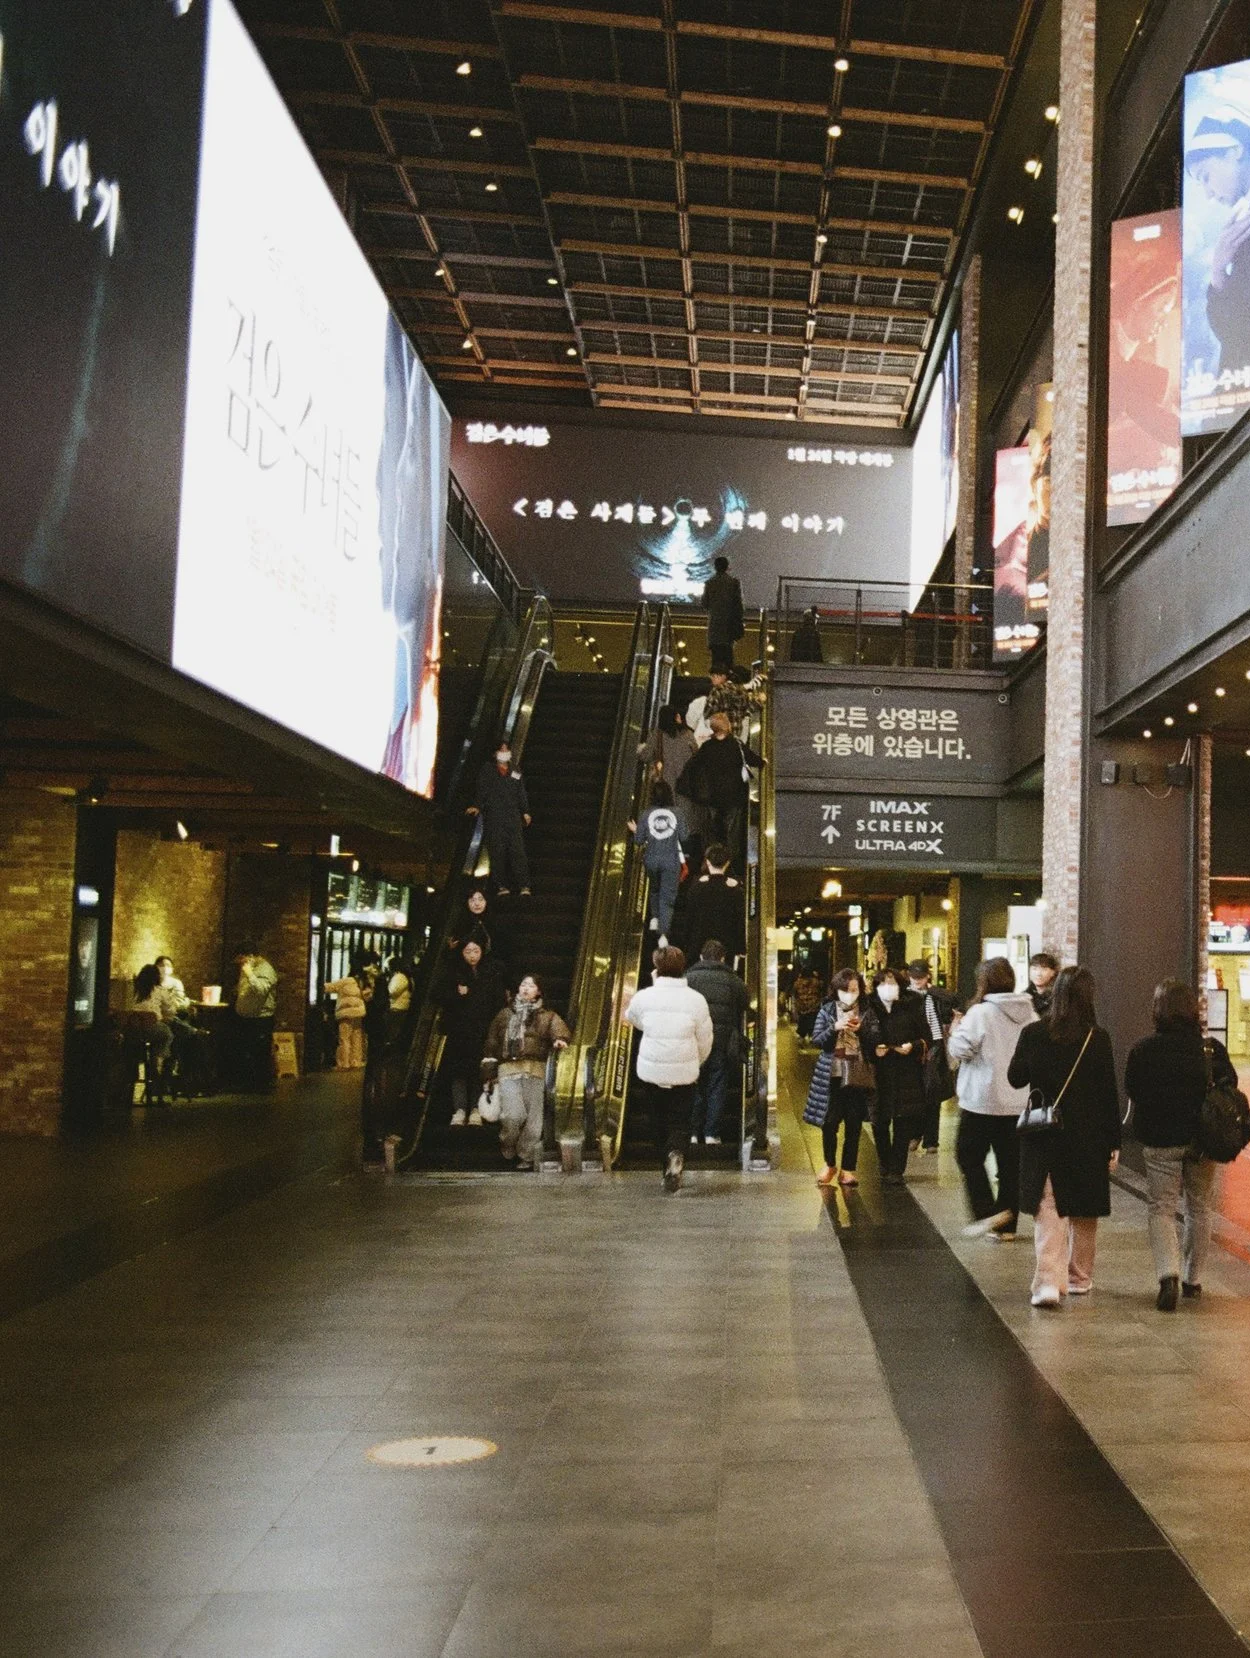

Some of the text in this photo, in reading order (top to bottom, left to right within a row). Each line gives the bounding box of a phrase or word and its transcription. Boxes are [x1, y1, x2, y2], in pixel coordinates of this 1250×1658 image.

[24, 97, 120, 257] 이야기
[781, 513, 844, 536] 이야기
[826, 706, 959, 732] 모든 상영관은
[812, 732, 972, 760] 위층에 있습니다.
[821, 800, 930, 821] 7F IMAX
[856, 819, 944, 834] SCREENX
[855, 839, 905, 851] ULTRA
